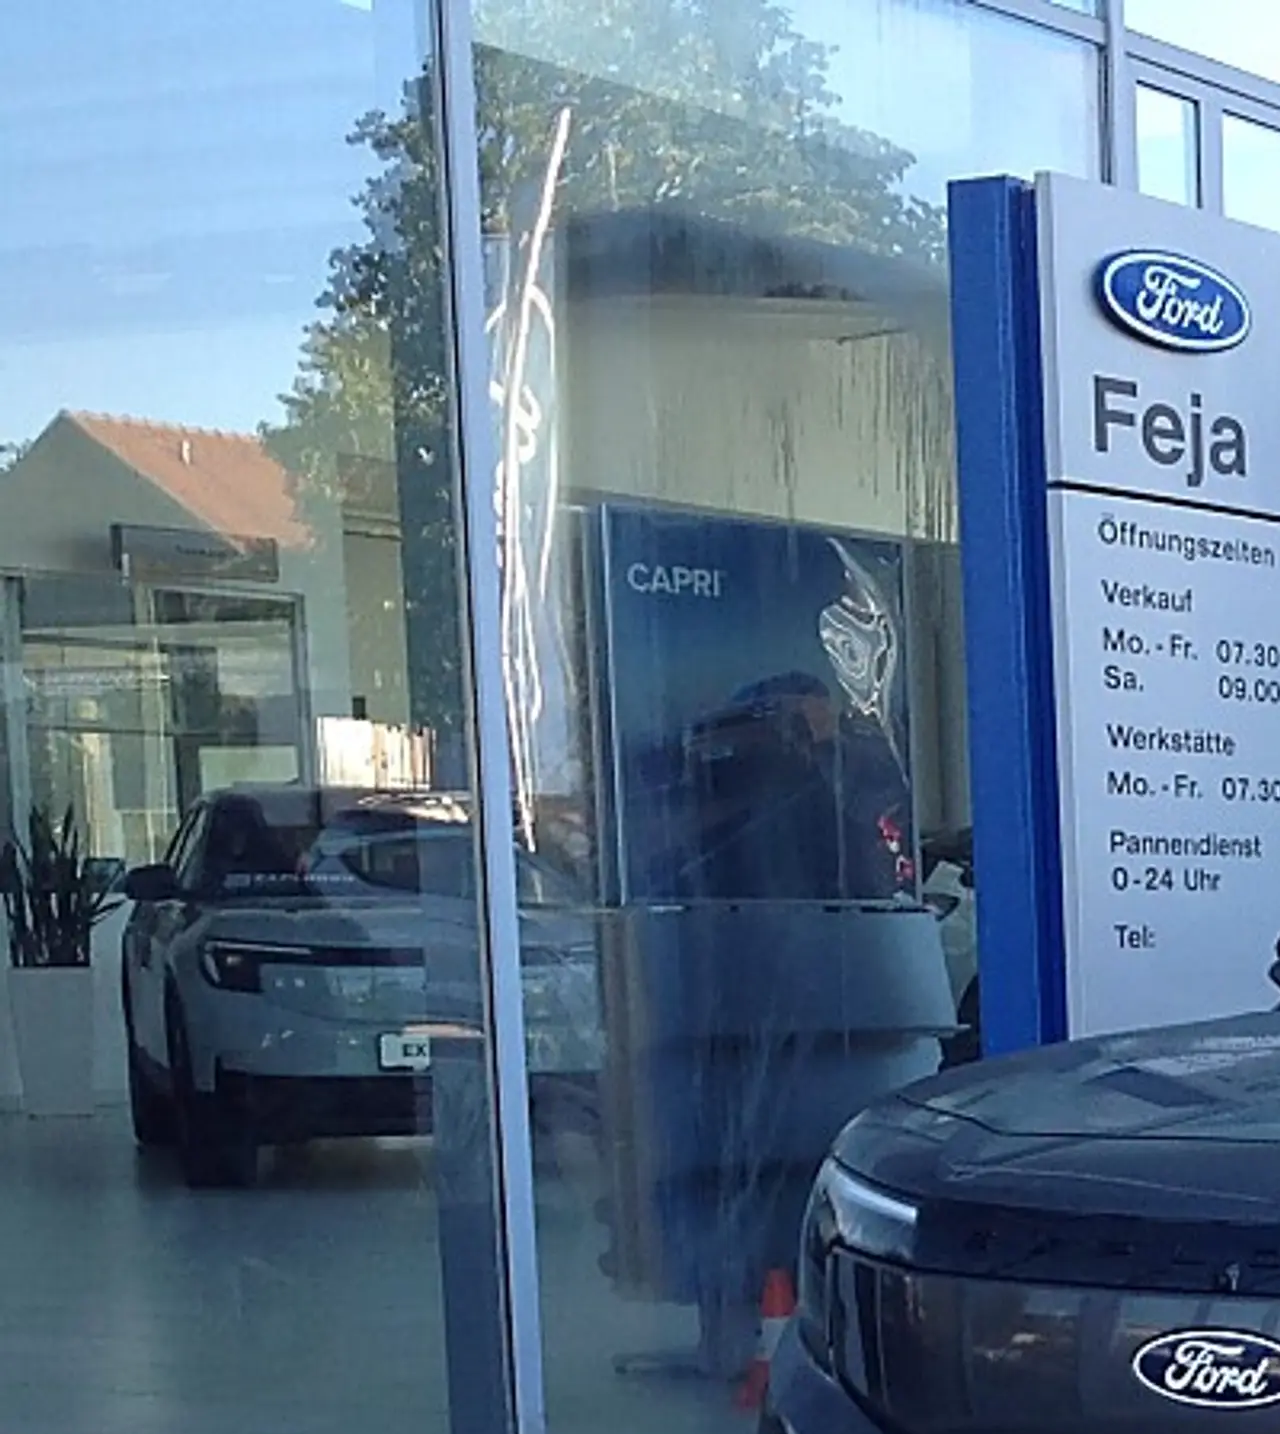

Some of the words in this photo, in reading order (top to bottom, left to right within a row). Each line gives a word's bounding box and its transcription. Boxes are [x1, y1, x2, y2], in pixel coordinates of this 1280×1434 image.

[1137, 266, 1223, 334] Ford
[1094, 374, 1246, 487] Feja
[1098, 513, 1275, 568] Öffnungszeiten
[627, 563, 722, 598] CAPRI
[1100, 579, 1193, 612] Verkauf
[1216, 639, 1280, 669] 07.30
[1103, 665, 1144, 692] Sa.
[1218, 676, 1280, 704] 09.00
[1106, 724, 1236, 757] Werkstätte
[1110, 830, 1262, 859] Pannendienst
[1184, 867, 1221, 892] Uhr
[1114, 925, 1156, 949] Tel:
[1164, 1340, 1268, 1396] Ford
